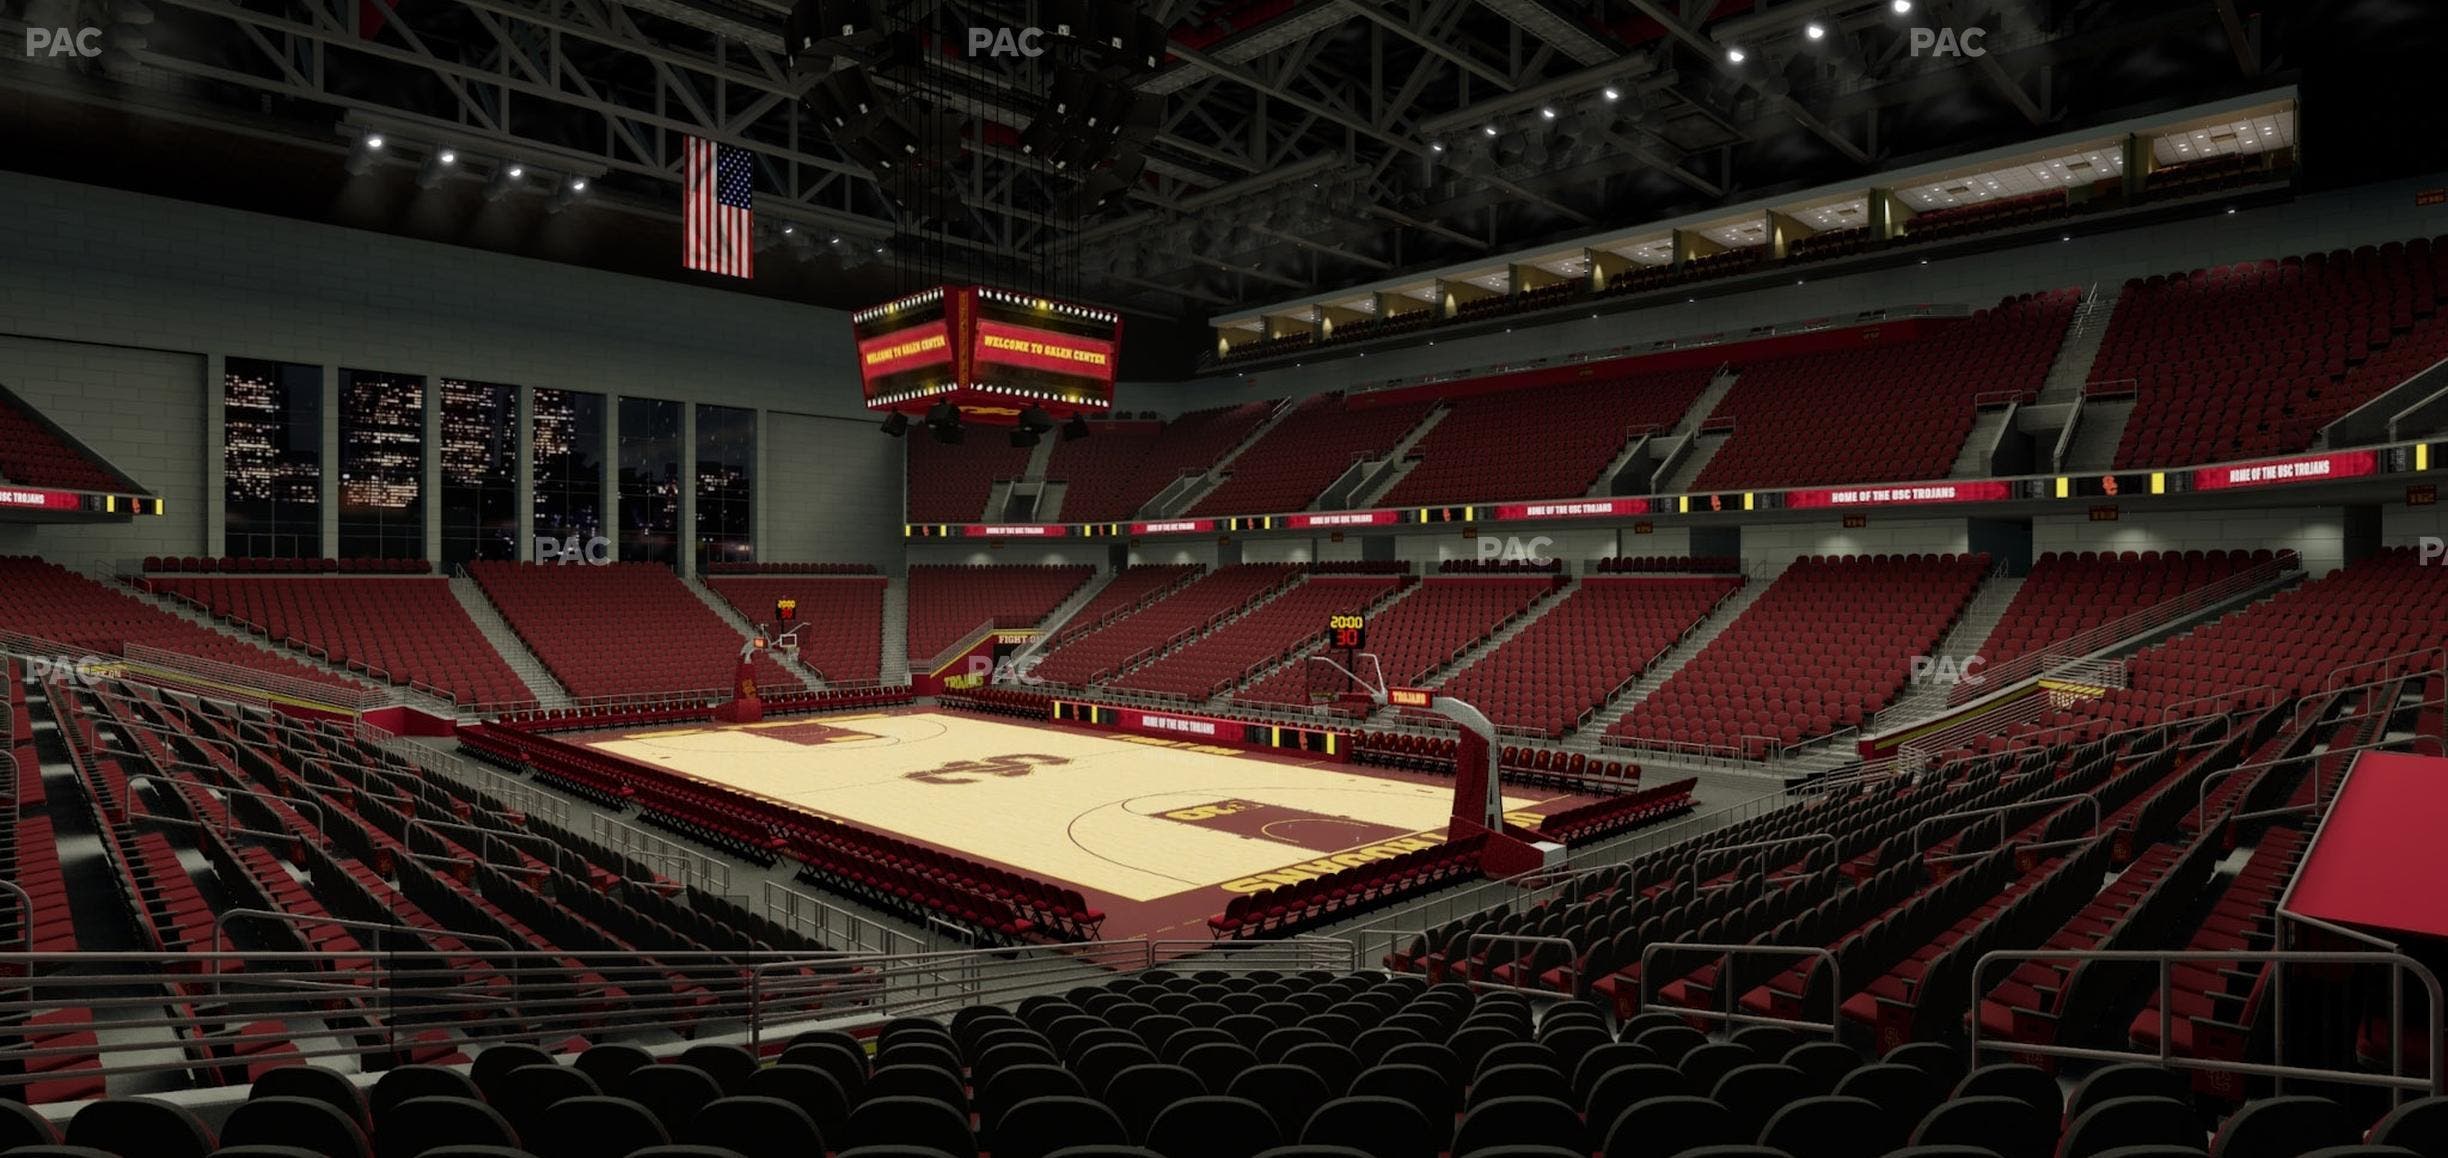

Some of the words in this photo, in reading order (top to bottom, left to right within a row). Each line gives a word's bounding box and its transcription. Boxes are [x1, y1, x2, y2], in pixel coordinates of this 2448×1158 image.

[893, 344, 903, 358] TO
[984, 335, 1029, 352] WELCOME
[1030, 342, 1043, 354] TO
[1044, 344, 1073, 359] GALEN
[1073, 350, 1105, 365] CENTER
[2230, 469, 2251, 482] HOME
[2251, 467, 2261, 480] OF
[2262, 466, 2277, 479] THE
[2278, 464, 2293, 477] USC
[2294, 460, 2330, 476] TROJANS
[1832, 492, 1857, 503] HOME
[1859, 491, 1871, 501] OF
[1873, 490, 1891, 501] THE
[1892, 489, 1911, 500] USC
[1912, 487, 1955, 499] TROJANS
[1527, 506, 1545, 515] HOME
[1546, 505, 1554, 514] OF
[1556, 505, 1568, 514] THE
[1568, 504, 1582, 514] USC
[1583, 503, 1612, 513] TROJANS
[1330, 615, 1363, 628] 20:00
[998, 635, 1028, 644] FIGHT
[1337, 629, 1358, 646] 30
